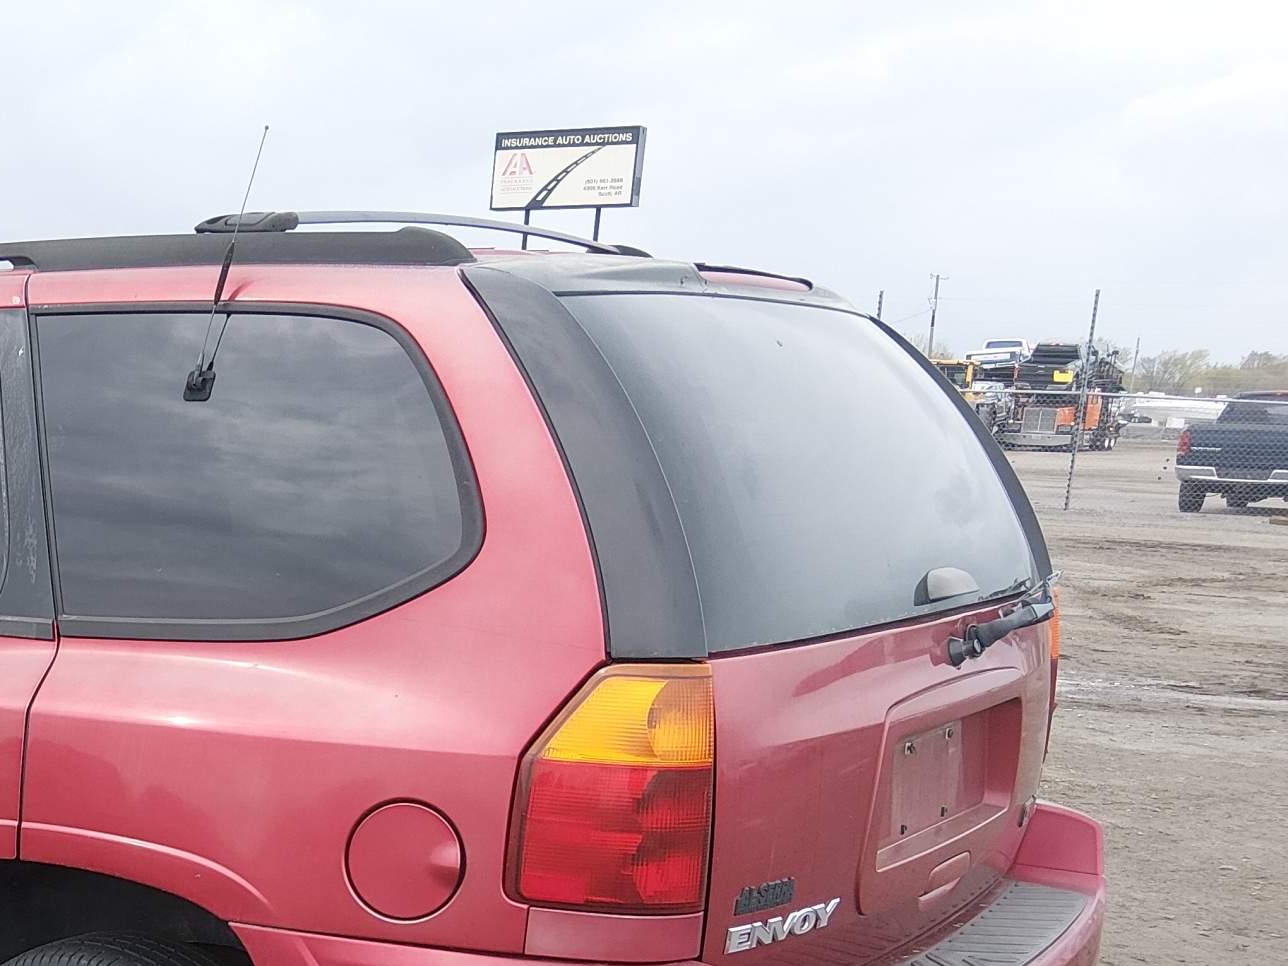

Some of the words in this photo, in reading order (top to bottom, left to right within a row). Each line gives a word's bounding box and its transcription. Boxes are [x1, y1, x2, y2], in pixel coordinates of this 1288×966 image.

[502, 137, 554, 147] INSURANCE
[556, 135, 581, 145] AUTO
[584, 133, 633, 144] AUCTIONS
[723, 897, 840, 954] ENVOY
